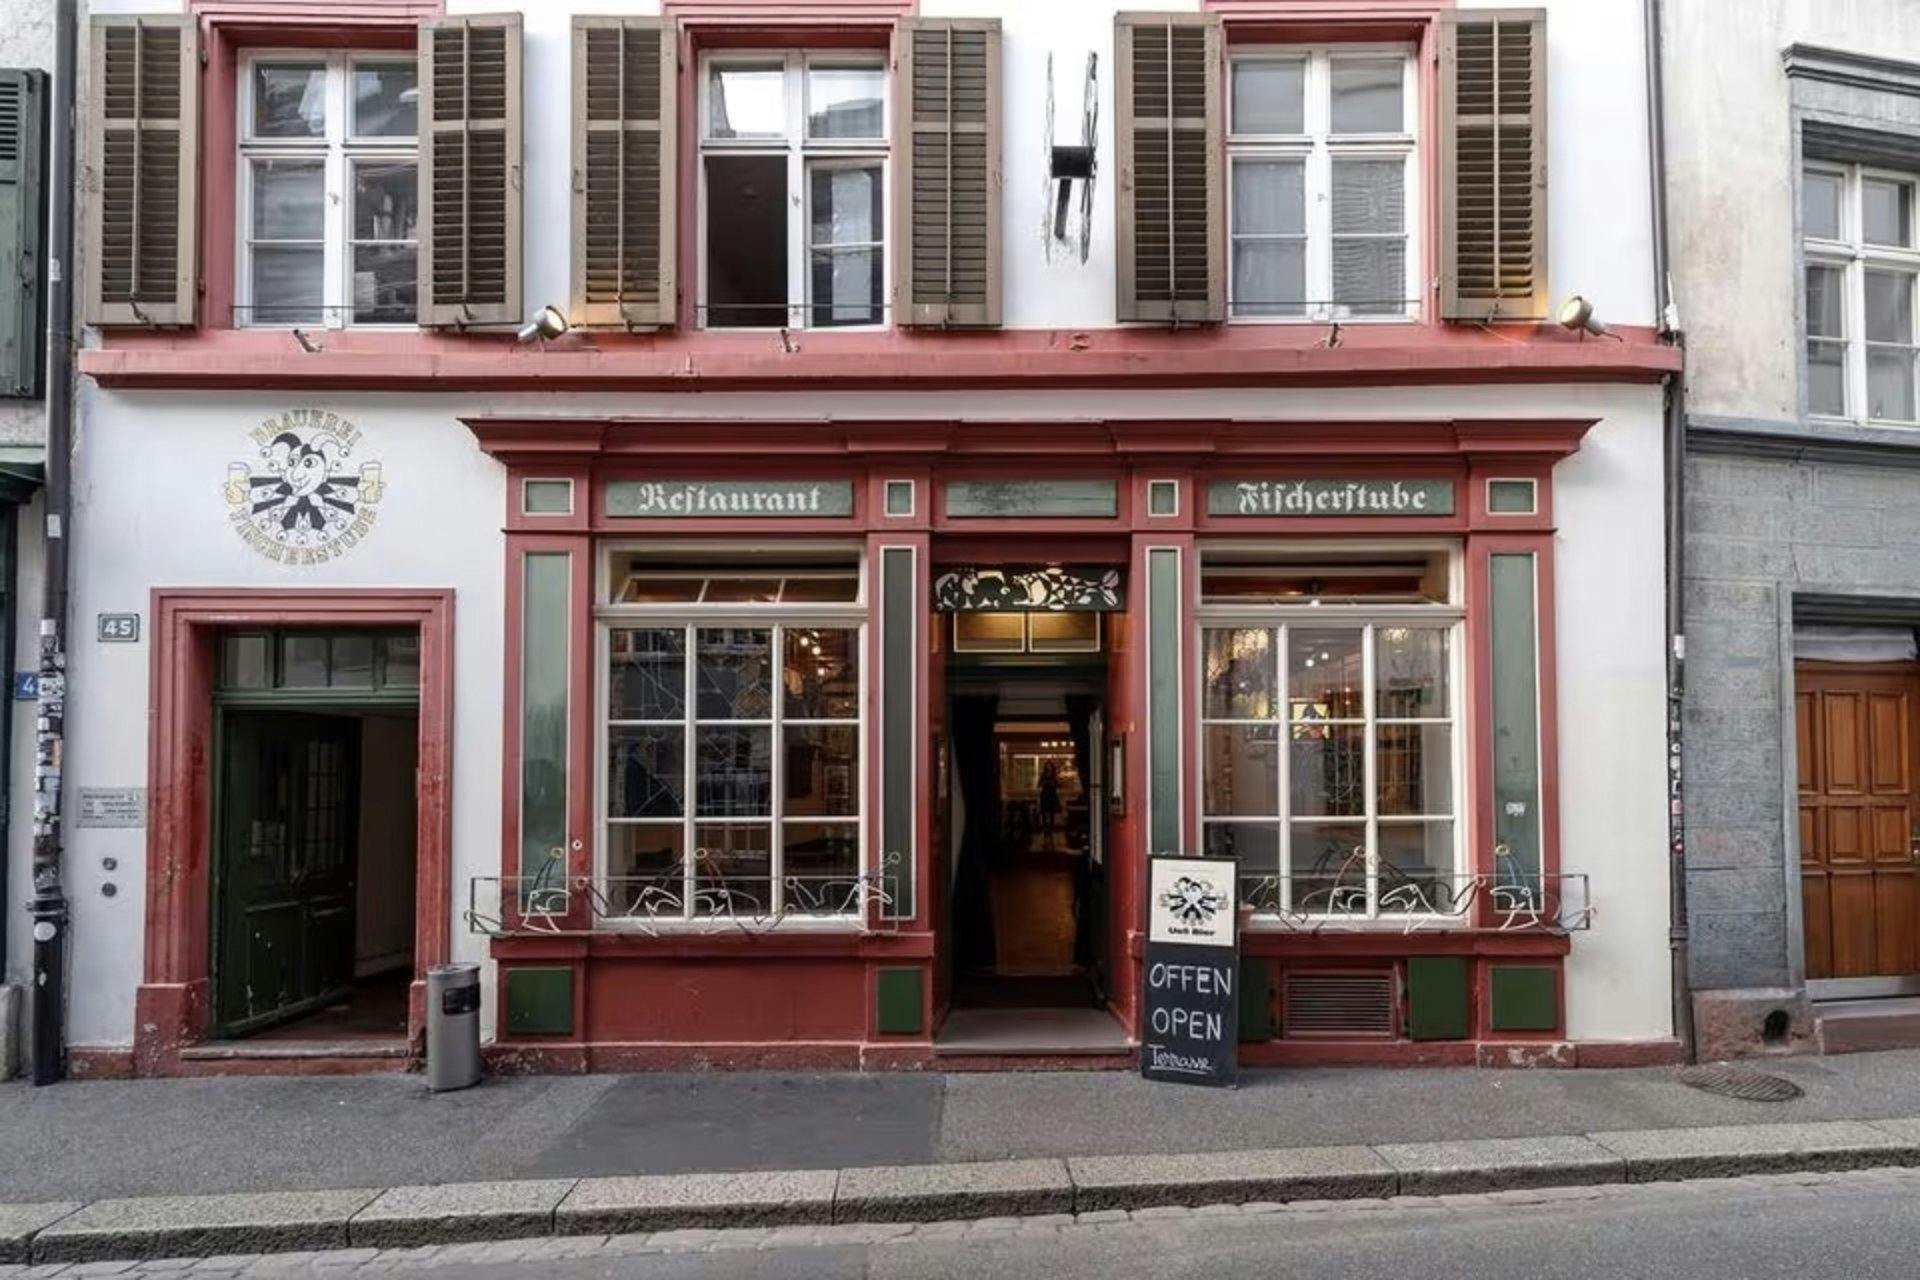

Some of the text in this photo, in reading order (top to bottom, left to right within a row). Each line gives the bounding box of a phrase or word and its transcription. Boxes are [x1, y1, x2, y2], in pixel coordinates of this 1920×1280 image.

[639, 482, 821, 514] Restaurant
[1236, 480, 1427, 514] Fischerstube
[104, 620, 131, 635] 45
[1149, 963, 1231, 996] OFFEN
[1152, 1007, 1221, 1041] OPEN
